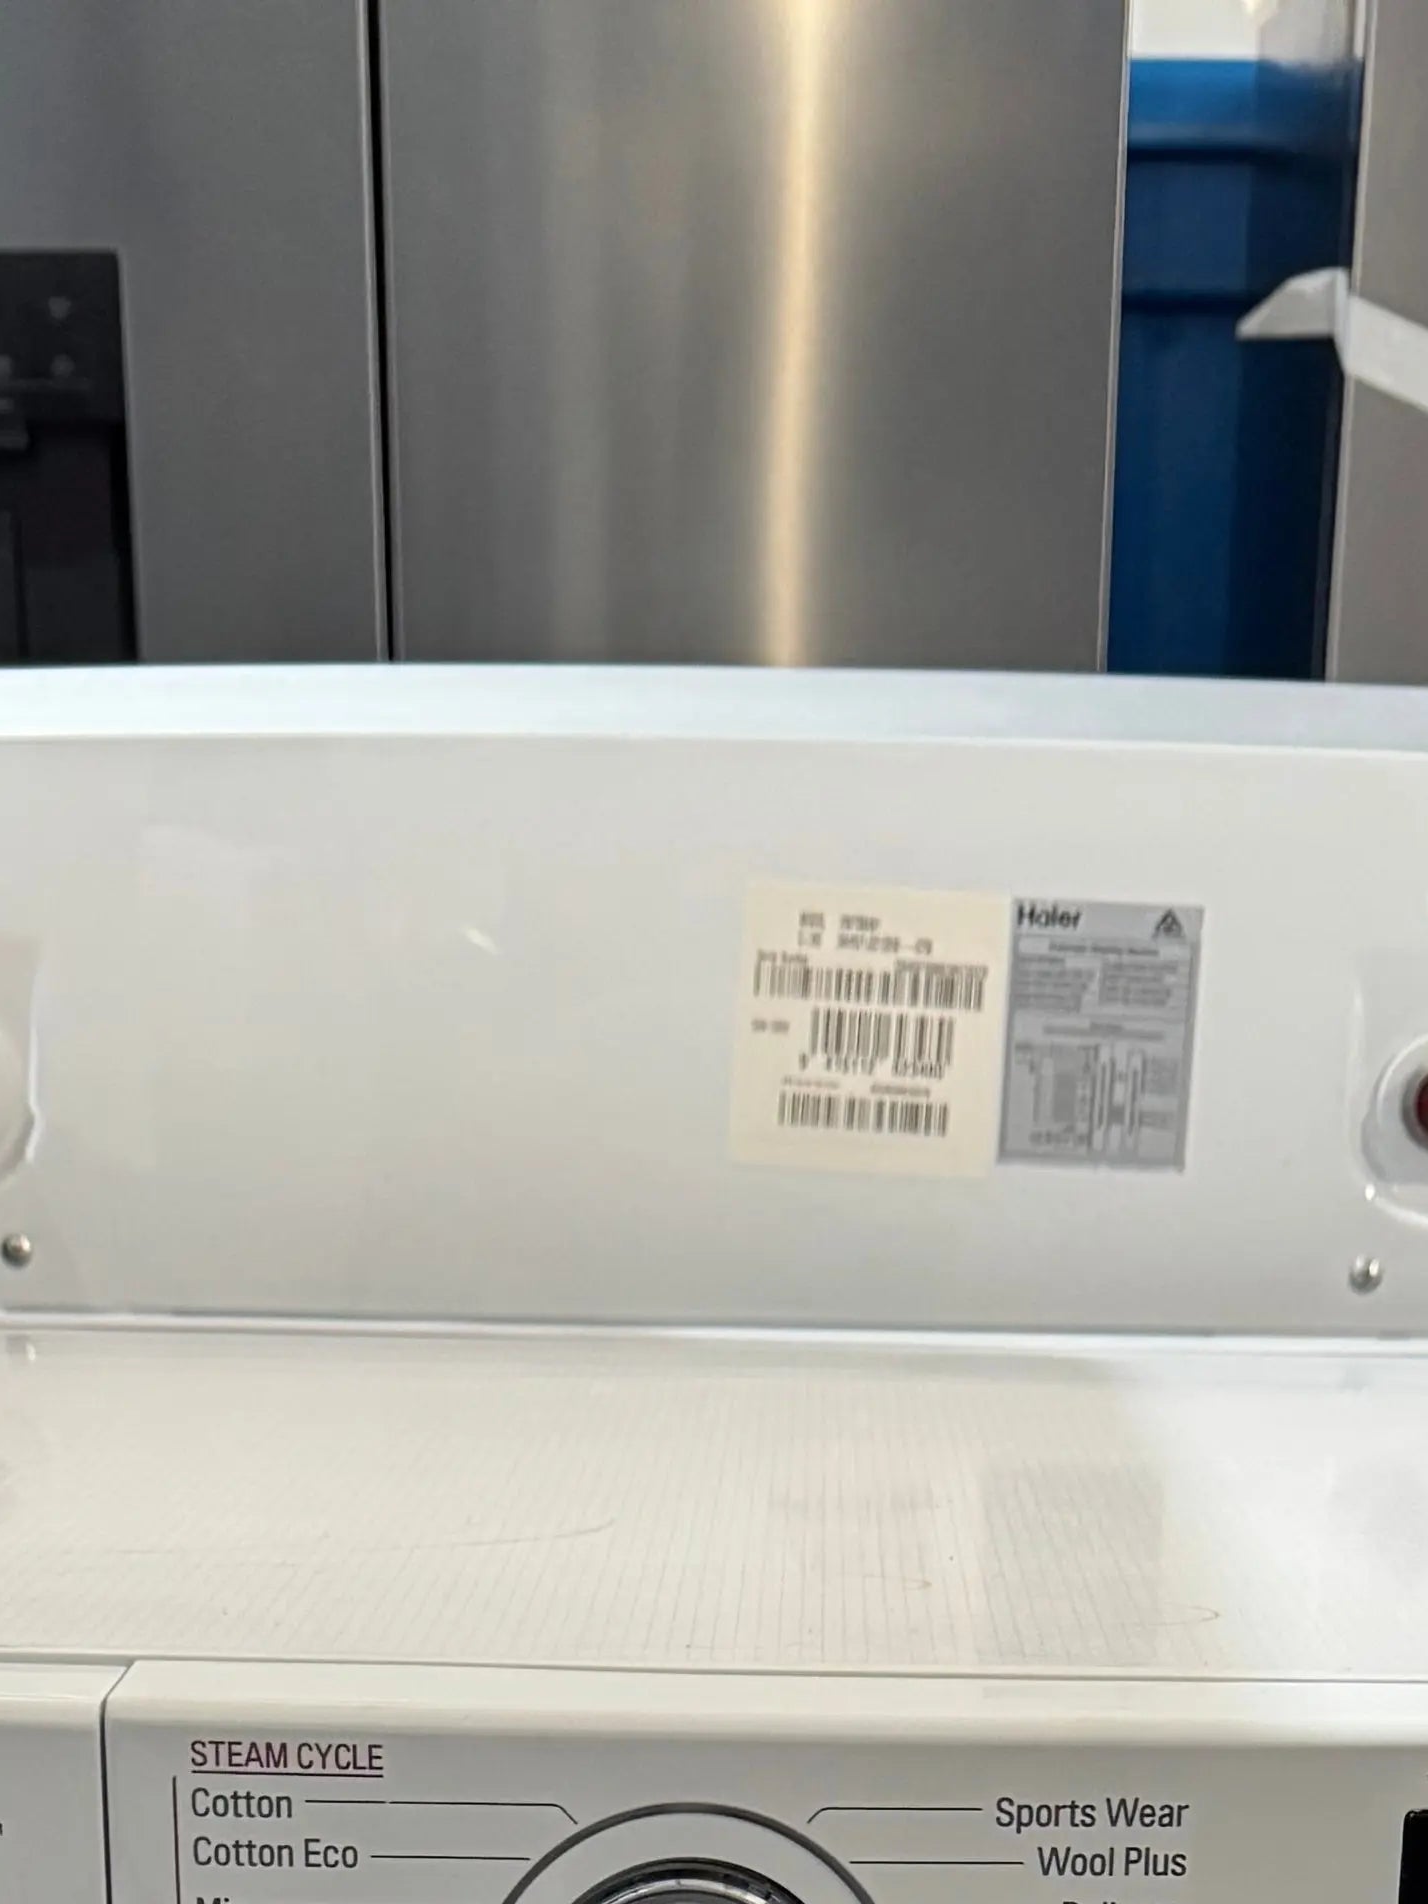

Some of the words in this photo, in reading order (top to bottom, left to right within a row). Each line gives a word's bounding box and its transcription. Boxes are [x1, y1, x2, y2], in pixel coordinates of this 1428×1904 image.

[1017, 904, 1082, 929] Haier
[191, 1741, 287, 1770] STEAM
[297, 1744, 383, 1771] CYCLE
[191, 1787, 292, 1819] Cotton
[996, 1798, 1096, 1833] Sports
[1106, 1800, 1189, 1827] Wear
[194, 1838, 293, 1868] Cotton
[304, 1841, 358, 1868] Eco
[1038, 1848, 1114, 1876] Wool
[1124, 1848, 1187, 1877] Plus
